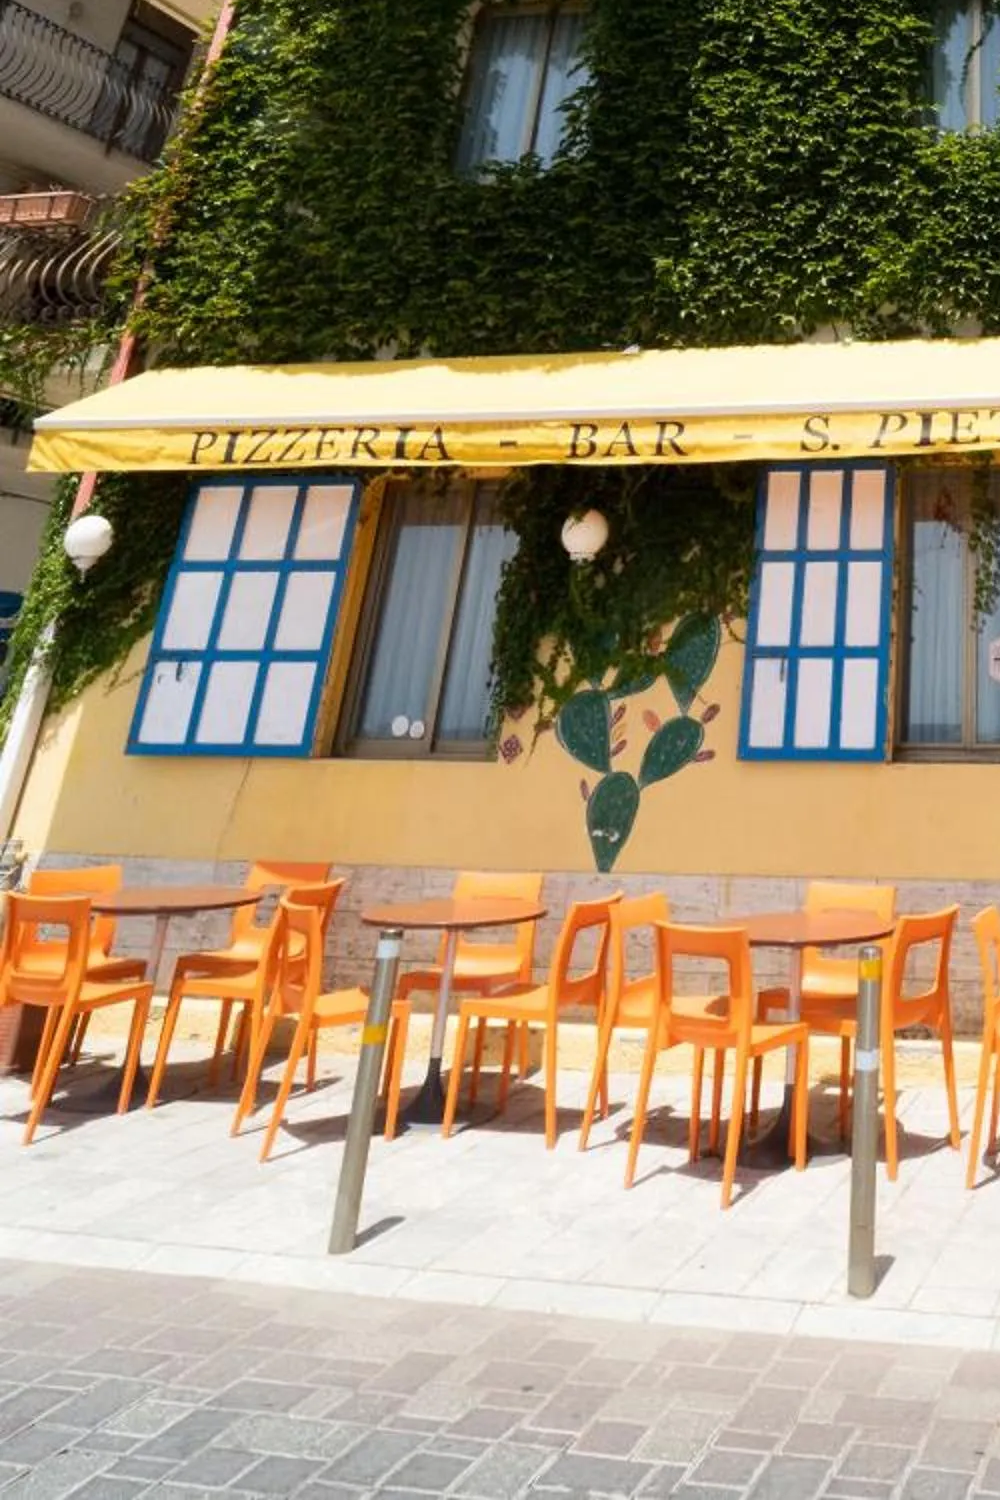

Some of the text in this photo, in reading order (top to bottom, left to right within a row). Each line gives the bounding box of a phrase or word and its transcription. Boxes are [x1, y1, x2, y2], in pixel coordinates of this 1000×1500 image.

[187, 424, 455, 464] PIZZERIA
[565, 420, 689, 459] BAR
[799, 414, 841, 452] S.
